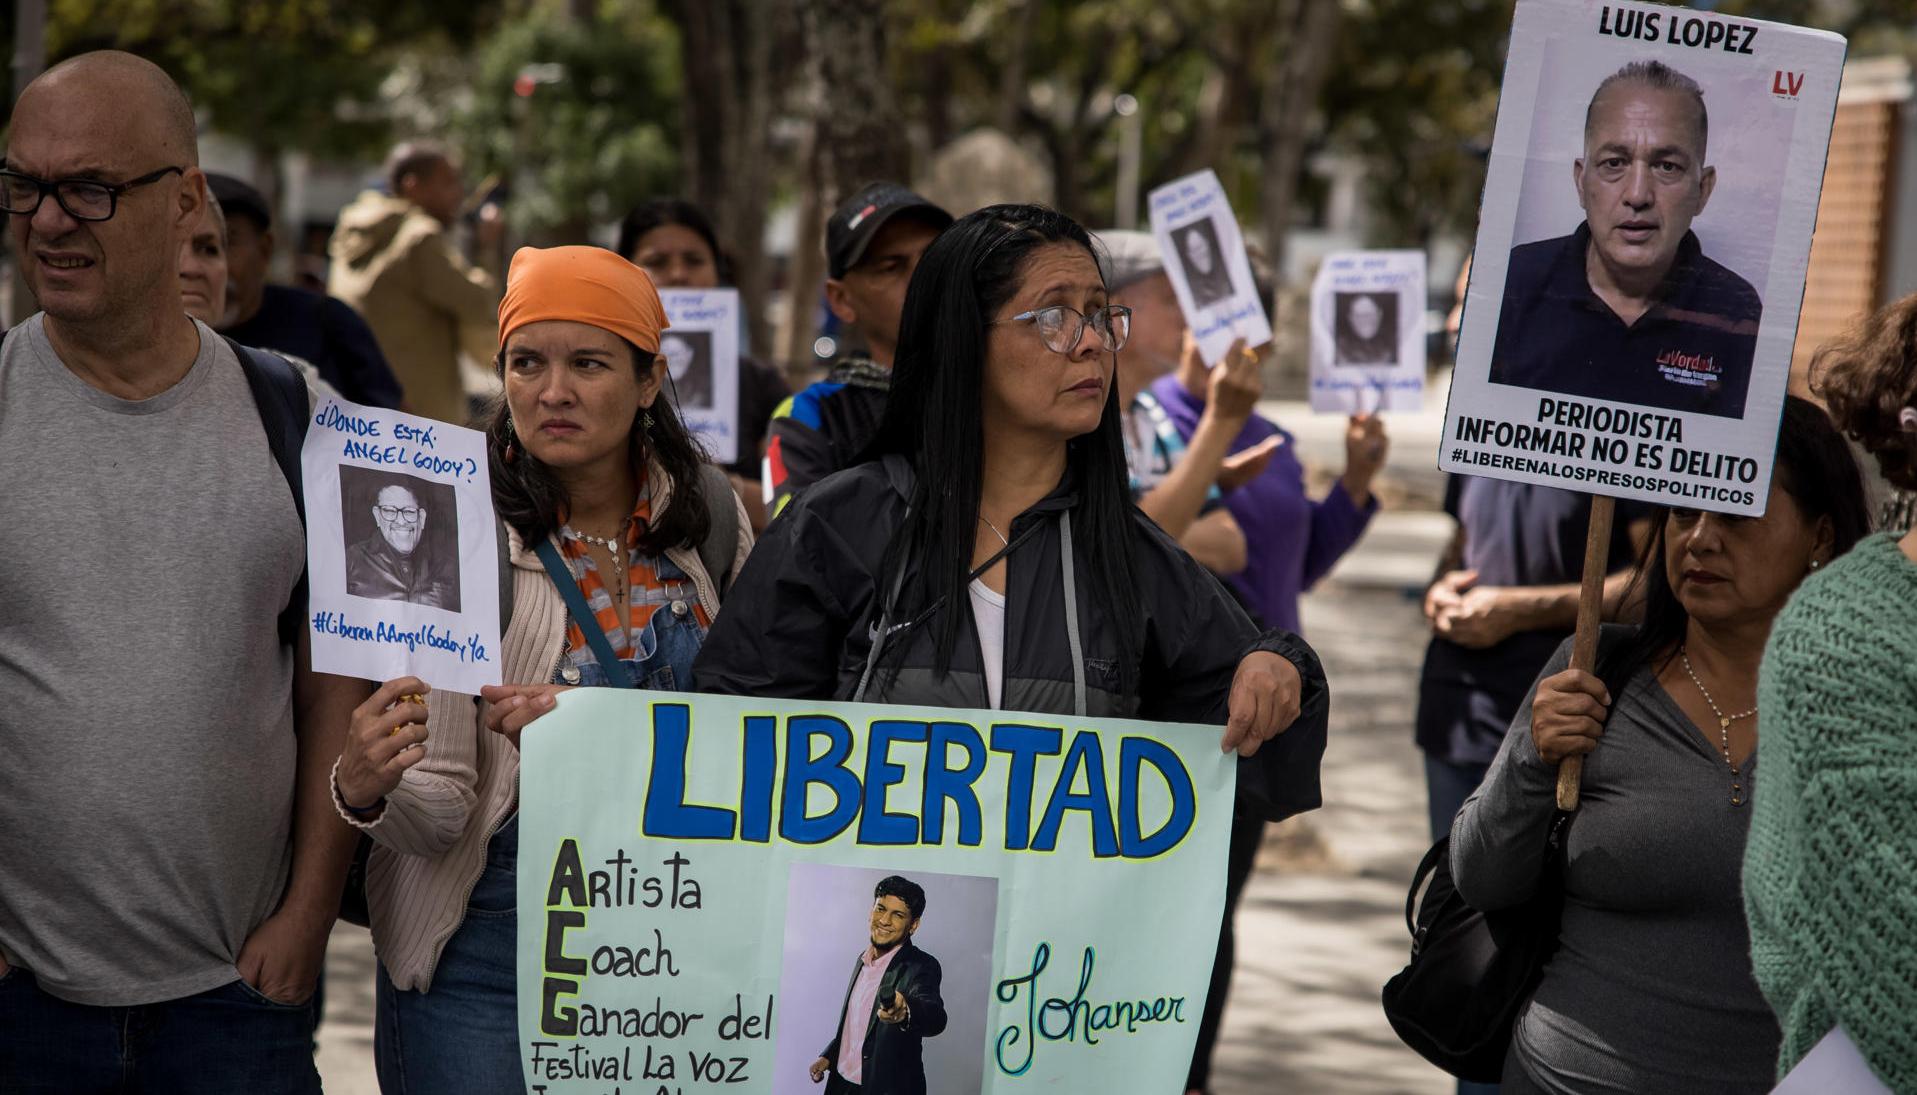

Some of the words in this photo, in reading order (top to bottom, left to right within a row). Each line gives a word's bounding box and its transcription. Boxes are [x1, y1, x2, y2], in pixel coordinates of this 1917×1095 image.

[1599, 6, 1661, 42] LUIS
[1668, 15, 1758, 55] LOPEZ
[1772, 70, 1804, 97] LV
[1456, 416, 1586, 460] INFORMAR
[1591, 436, 1629, 465] NO
[1635, 442, 1663, 471] ES
[1670, 448, 1758, 484] DELITO
[1537, 397, 1682, 443] PERIODISTA
[343, 439, 408, 464] ANGEL
[413, 451, 477, 483] GODOY?
[1451, 449, 1755, 506] #LIBERENALOSPRESOSPOLITICOS
[641, 703, 1196, 859] LIBERTAD
[545, 910, 680, 977] Coach
[541, 976, 704, 1039] Ganador
[718, 993, 774, 1040] del
[995, 941, 1186, 1076] Johanser
